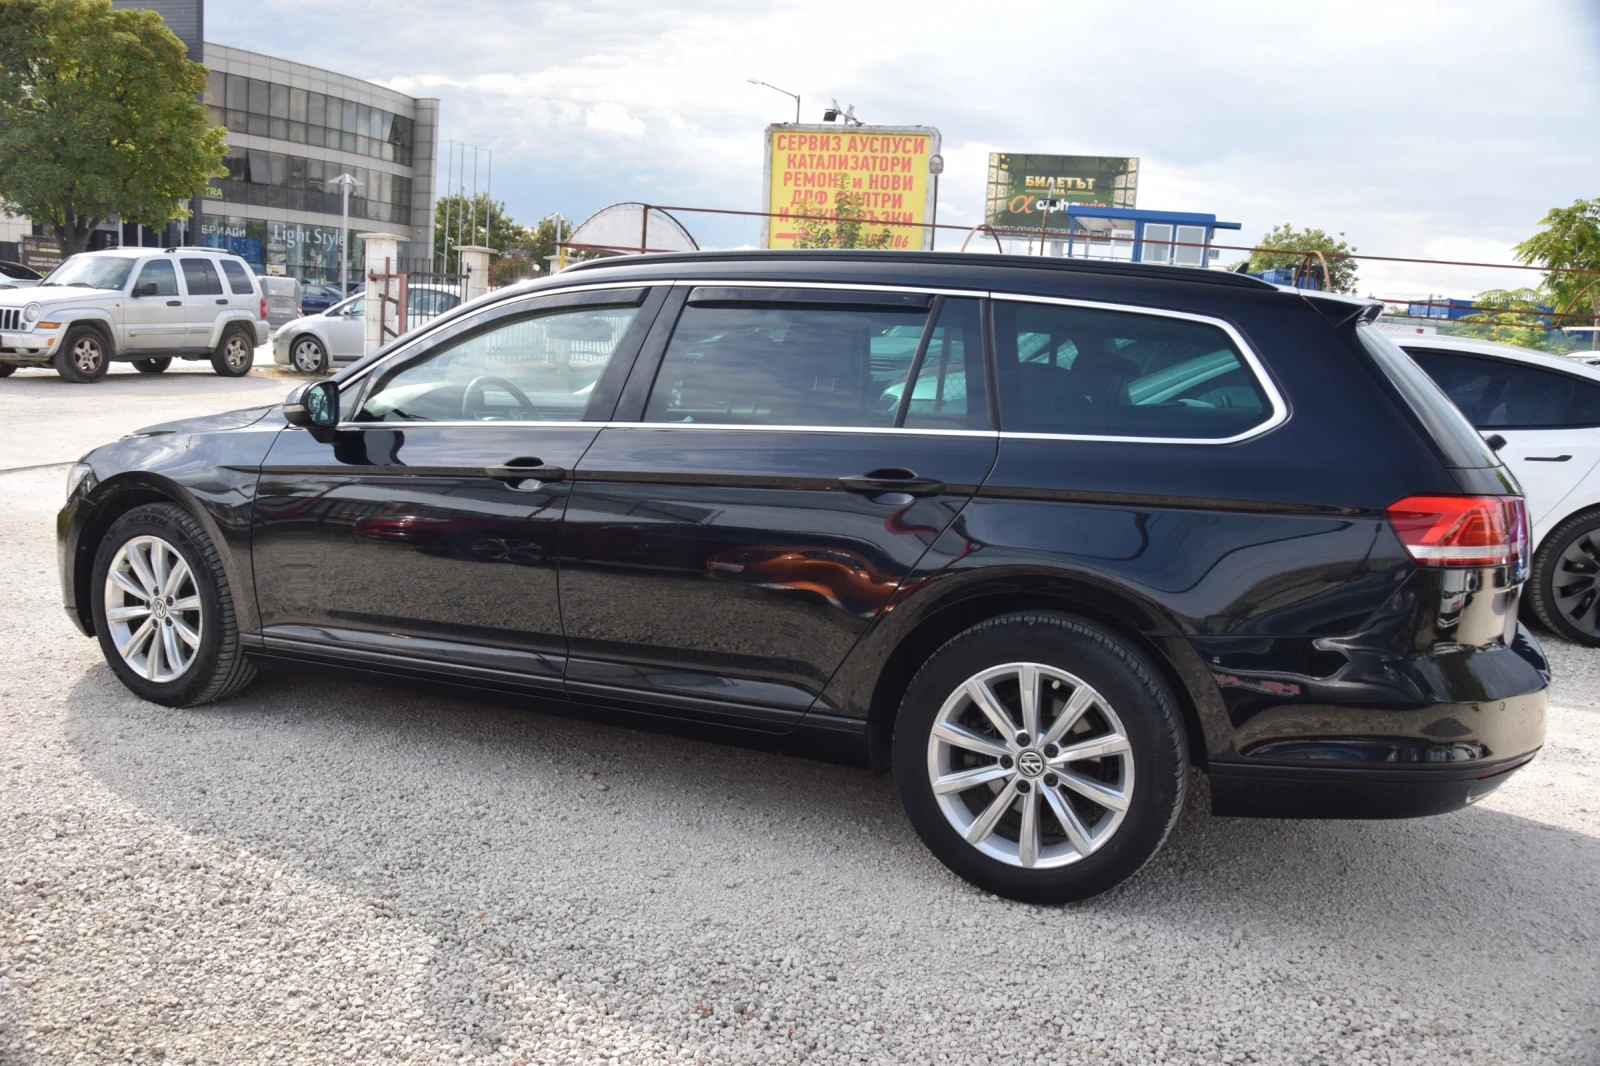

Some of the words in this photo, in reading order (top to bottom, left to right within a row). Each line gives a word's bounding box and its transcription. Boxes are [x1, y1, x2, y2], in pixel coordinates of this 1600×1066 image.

[777, 134, 842, 152] СЕРВИЗ
[847, 135, 925, 154] АУСПУСИ
[787, 153, 912, 172] КАТАЛИЗАТОРИ
[869, 174, 913, 191] НОВИ
[1025, 175, 1095, 189] БИЛЕТЪТ
[790, 189, 828, 207] ДПФ
[834, 190, 903, 209] ФИЛТРИ
[779, 206, 790, 222] И
[846, 209, 914, 228] РЪЗКИ
[274, 224, 311, 248] Light
[314, 228, 344, 251] Style
[889, 234, 909, 248] 106
[300, 257, 327, 268] Sound
[126, 513, 169, 528] NEXEN
